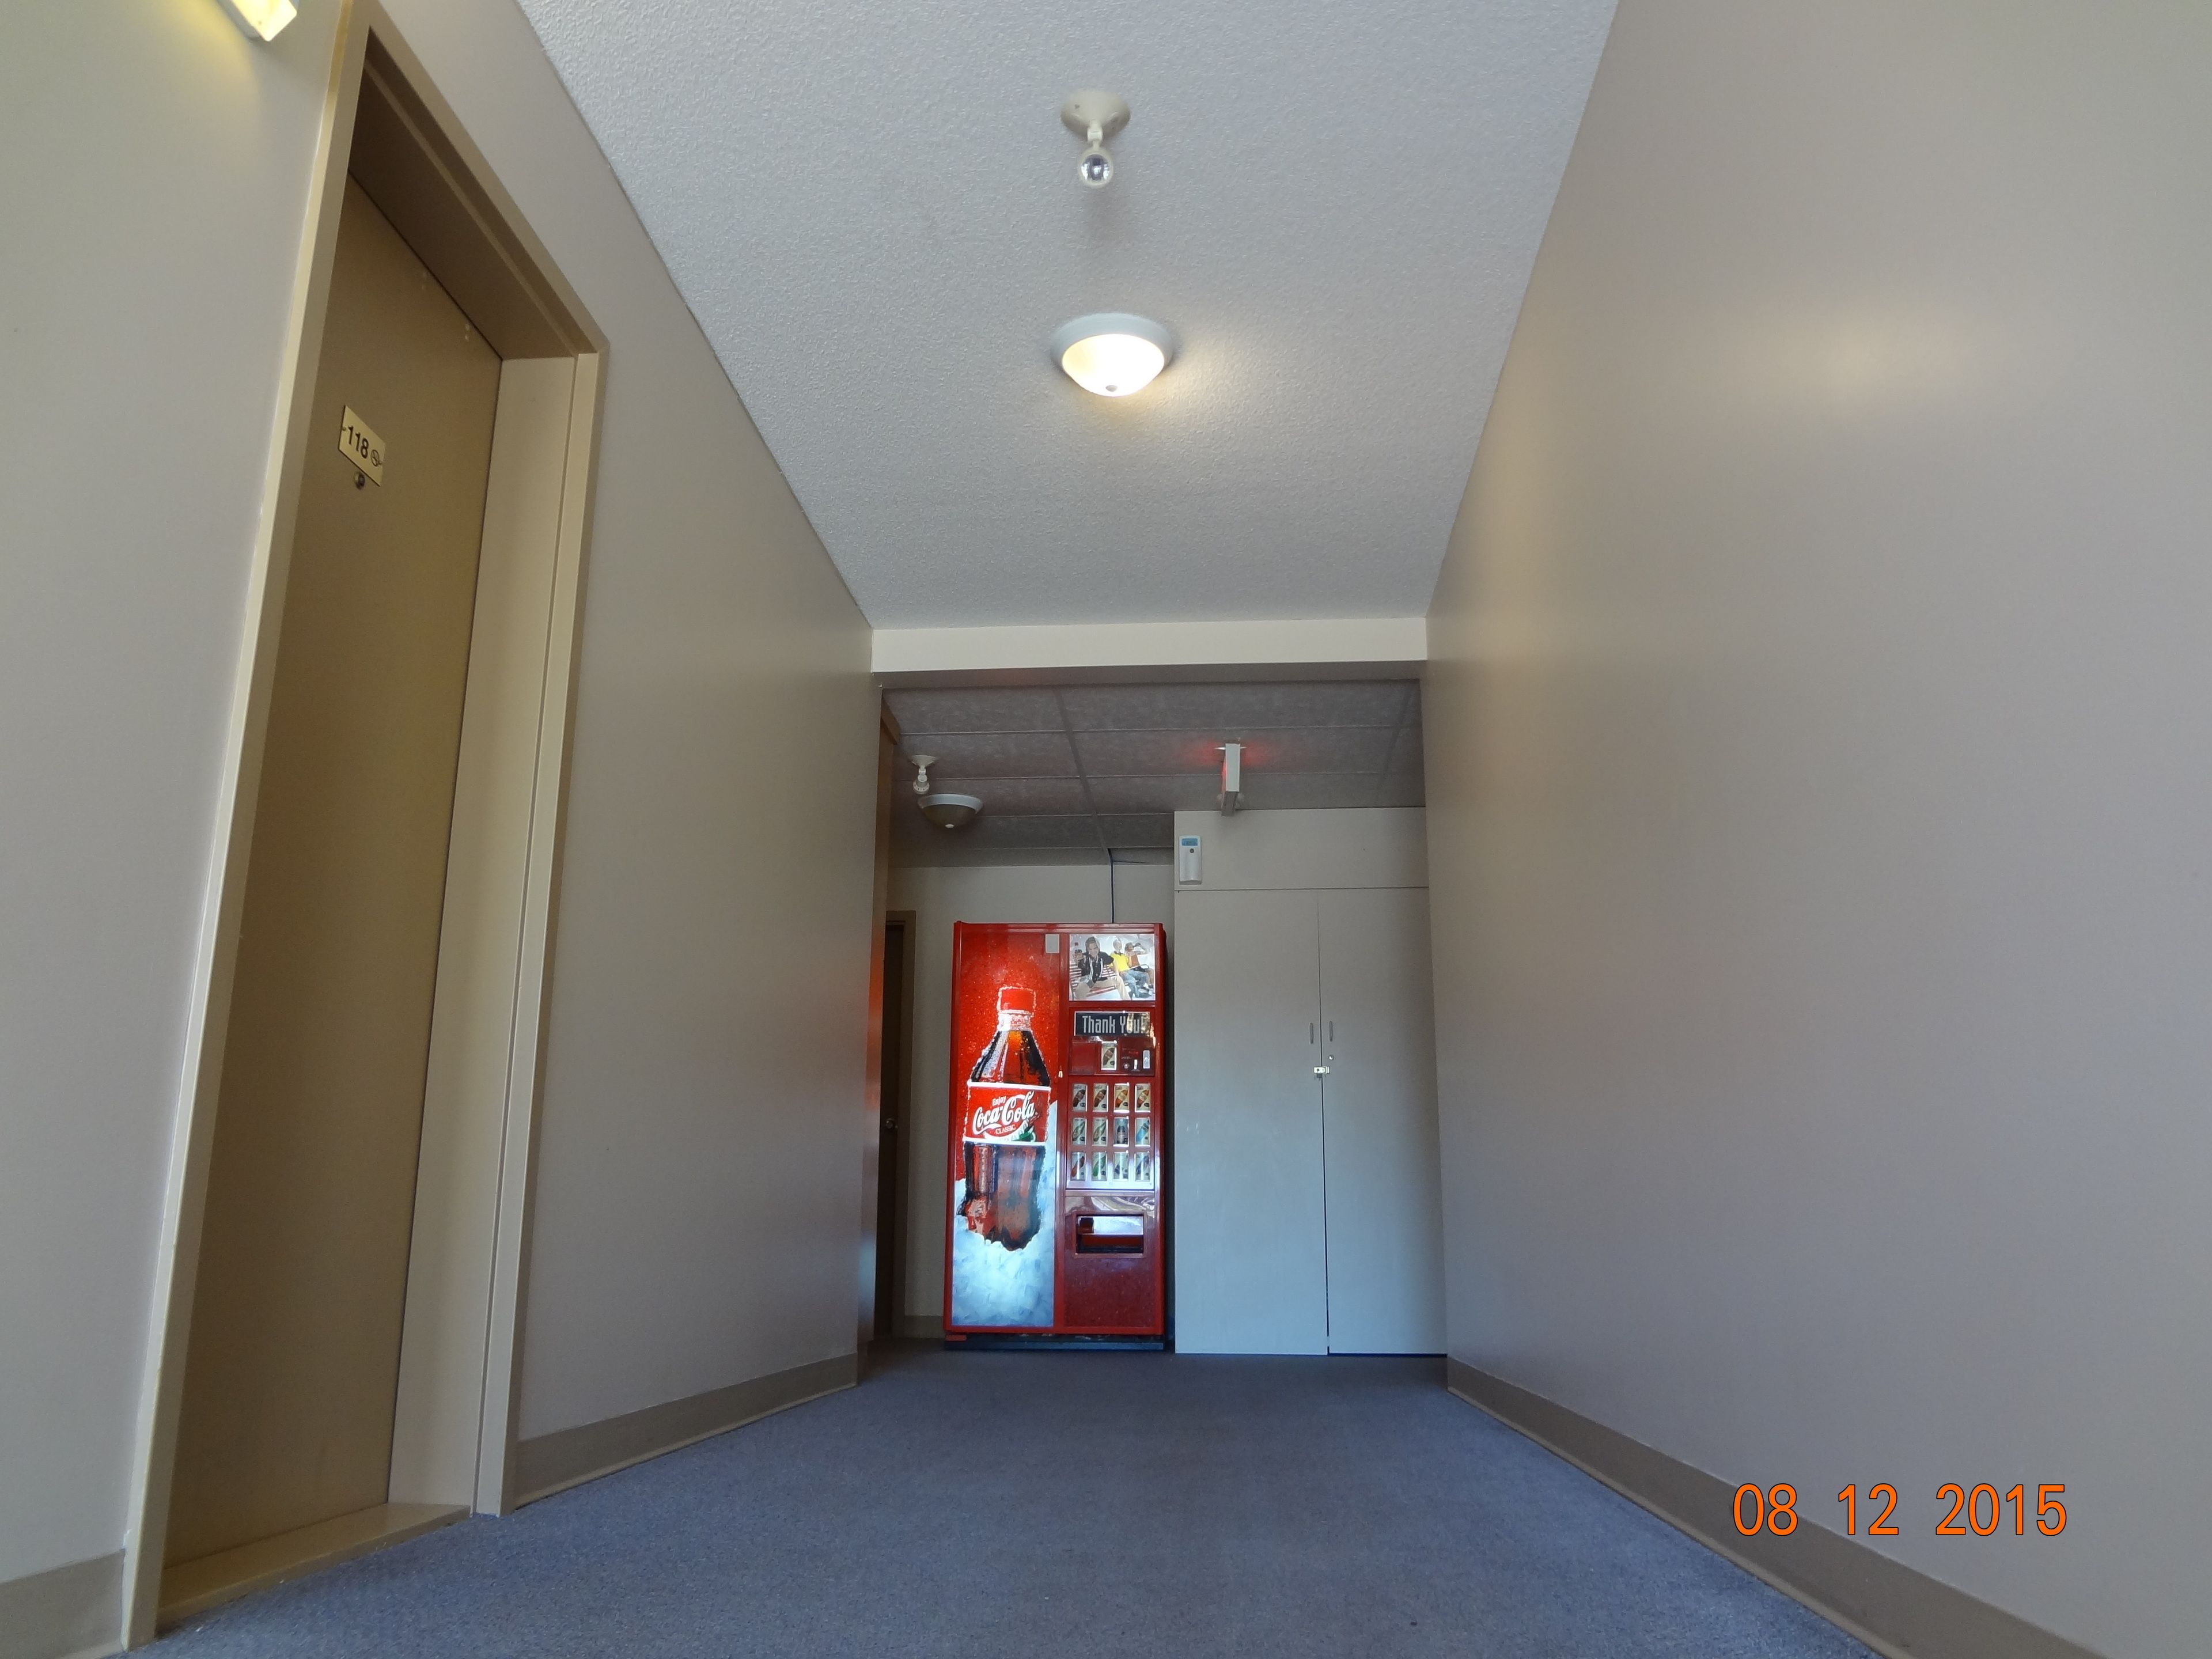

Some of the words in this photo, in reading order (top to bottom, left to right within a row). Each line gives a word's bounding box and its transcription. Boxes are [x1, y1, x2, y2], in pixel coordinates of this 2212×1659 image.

[348, 425, 369, 459] 118
[1082, 1016, 1116, 1033] Thank
[992, 1096, 1007, 1106] Enjoy
[972, 1090, 1035, 1135] Coca-Cola
[995, 1124, 1016, 1135] CLASSIC
